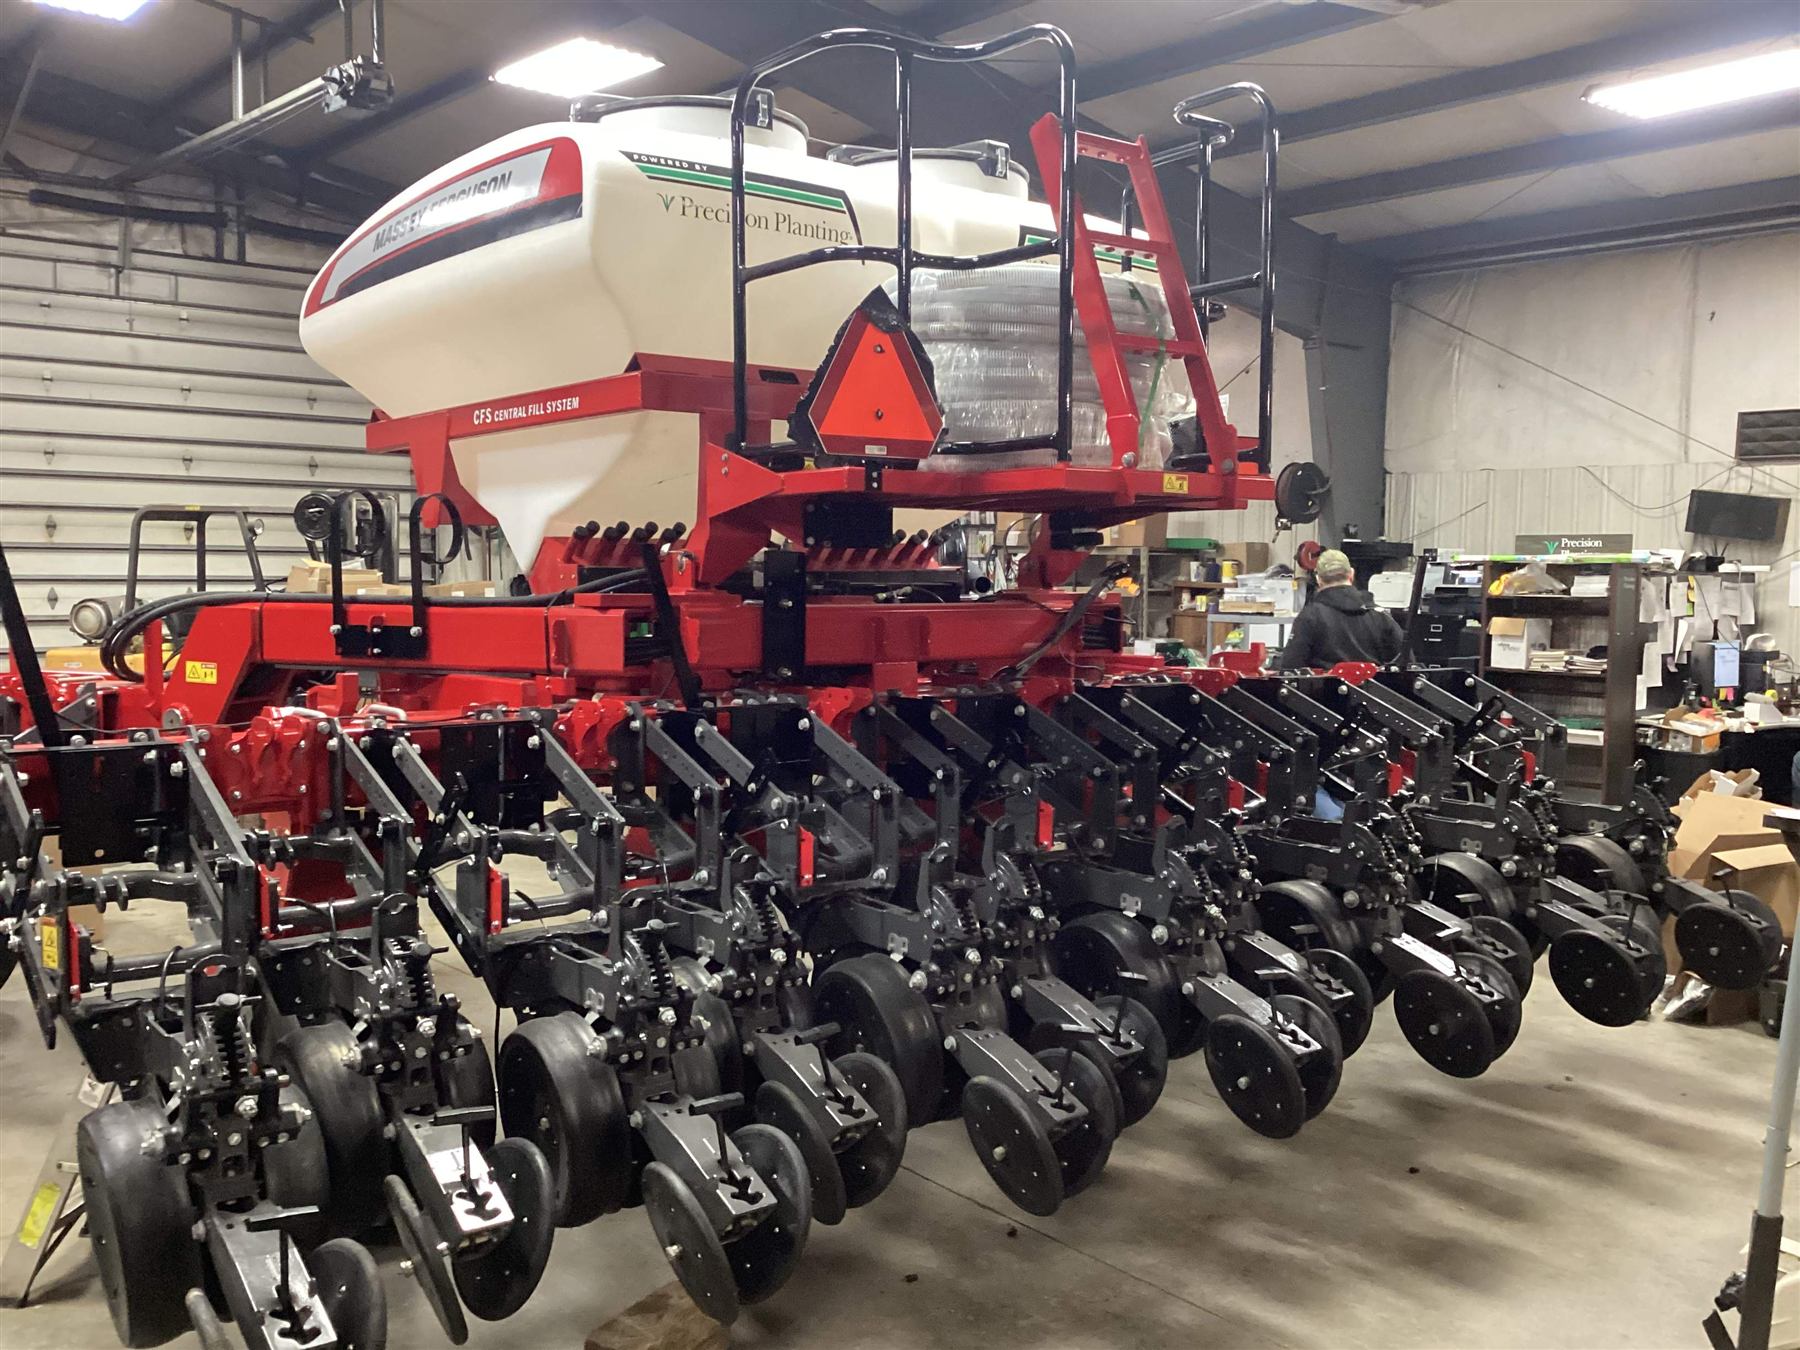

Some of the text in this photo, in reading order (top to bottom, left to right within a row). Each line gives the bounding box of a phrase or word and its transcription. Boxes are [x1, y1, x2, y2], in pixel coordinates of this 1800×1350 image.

[633, 153, 708, 172] POWERED BY
[680, 195, 849, 246] Precion Planting
[473, 396, 580, 425] CFS CENTRAL FILL SYSTEM
[1560, 537, 1603, 548] Precision
